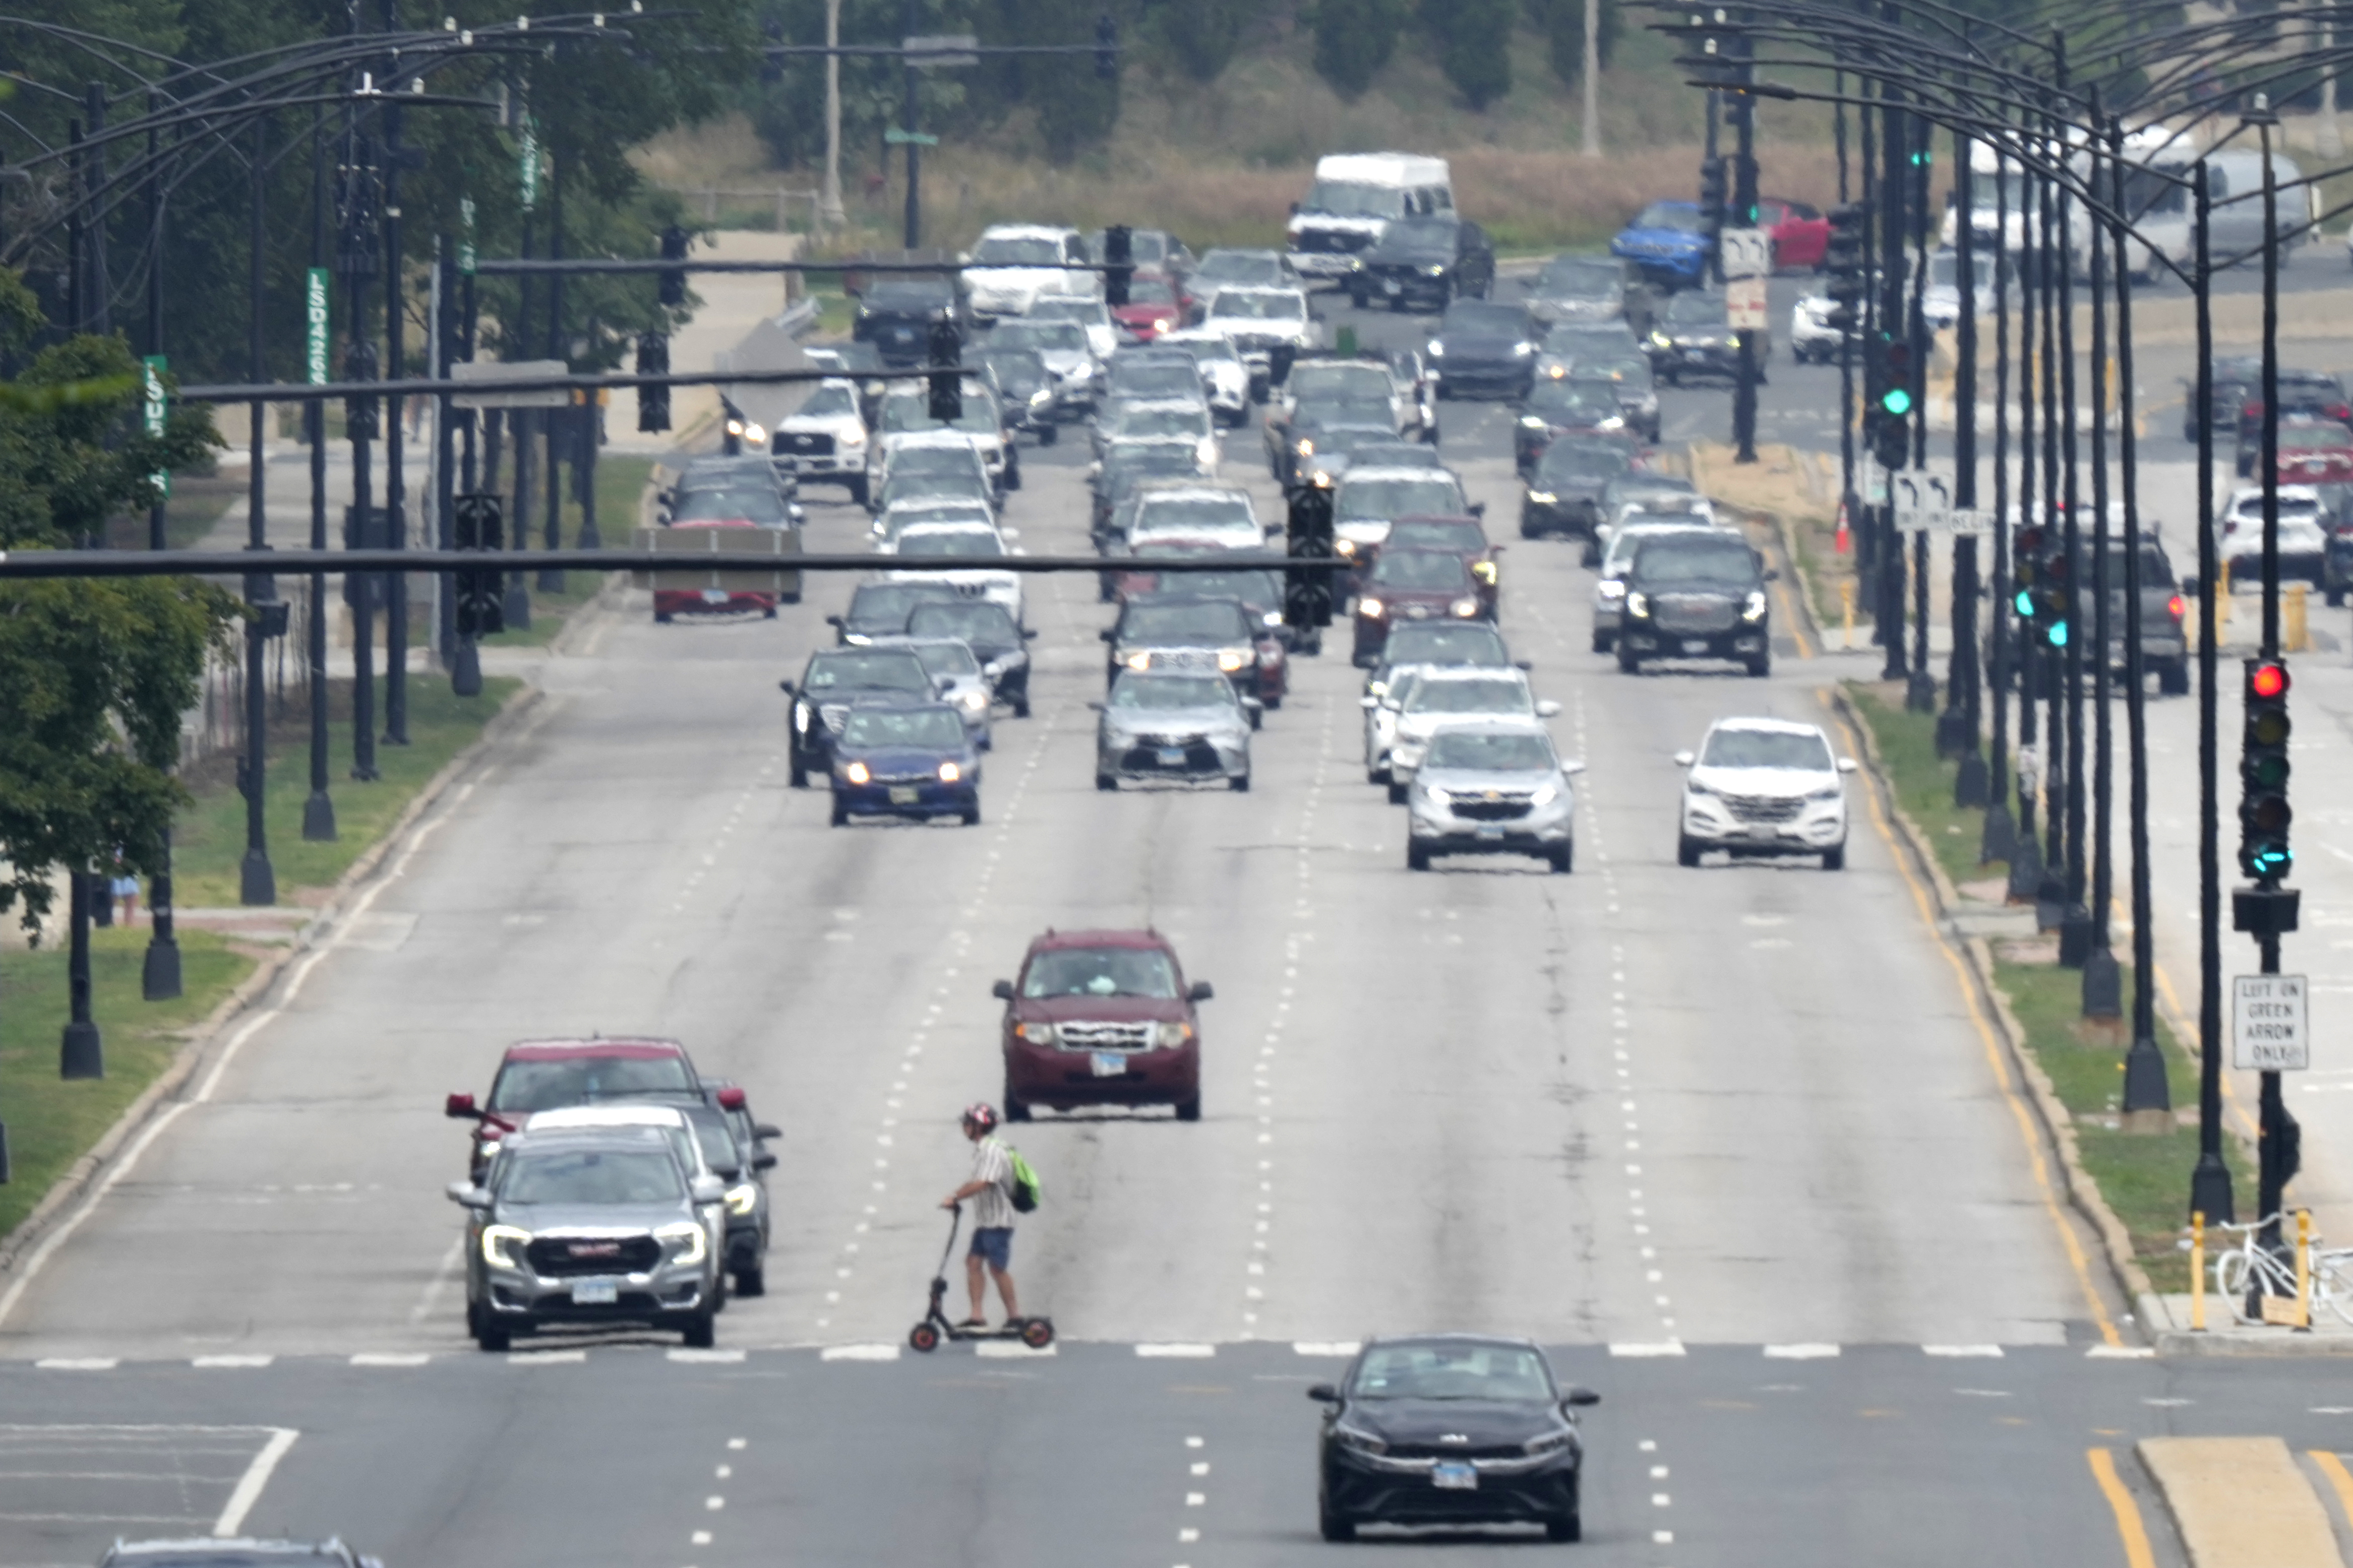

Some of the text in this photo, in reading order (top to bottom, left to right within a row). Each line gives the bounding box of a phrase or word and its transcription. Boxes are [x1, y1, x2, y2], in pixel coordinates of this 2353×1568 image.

[2249, 1003, 2293, 1019] GREEN
[2246, 1024, 2295, 1039] ARROW
[2252, 1045, 2288, 1061] ONLY
